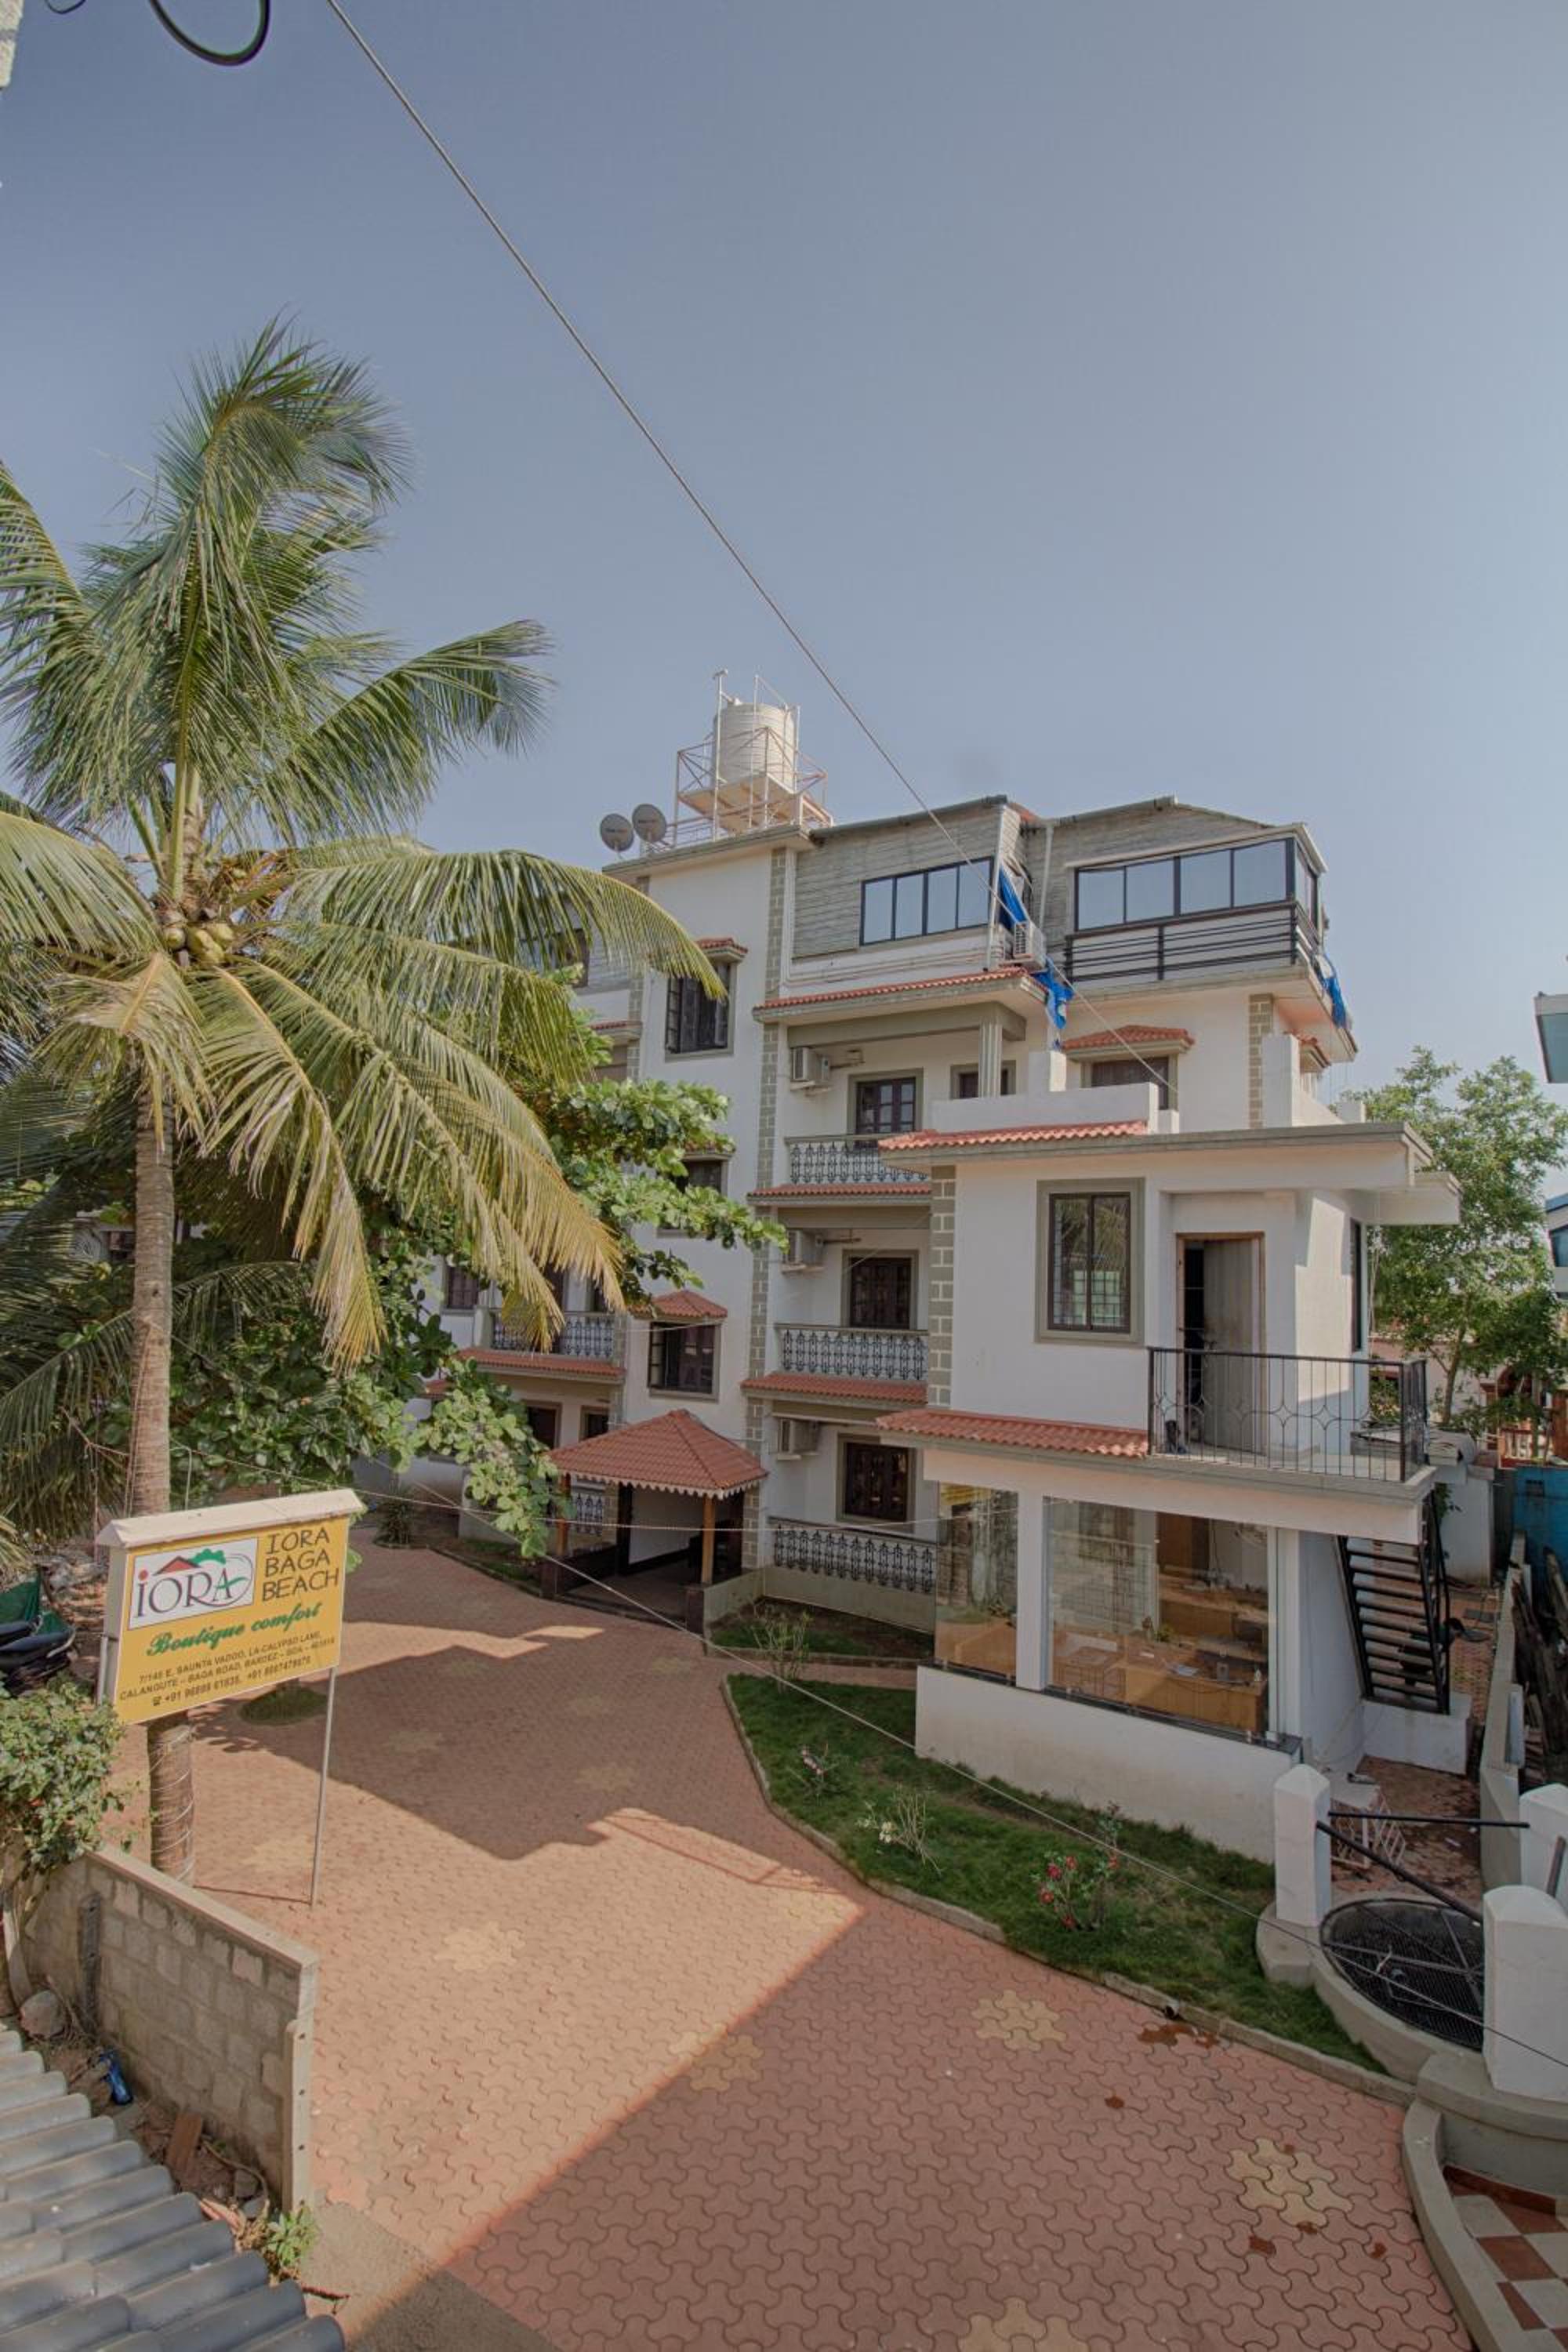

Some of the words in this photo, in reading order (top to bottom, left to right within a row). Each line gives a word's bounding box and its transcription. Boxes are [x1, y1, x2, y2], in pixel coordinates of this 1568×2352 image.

[264, 1526, 330, 1555] IORA
[264, 1549, 330, 1577] BAGA
[261, 1567, 339, 1602] BEACH
[146, 1624, 245, 1656] Boutique
[250, 1602, 322, 1632] comfort
[119, 1678, 178, 1700] CALANGUTE
[187, 1669, 214, 1683] BAGA
